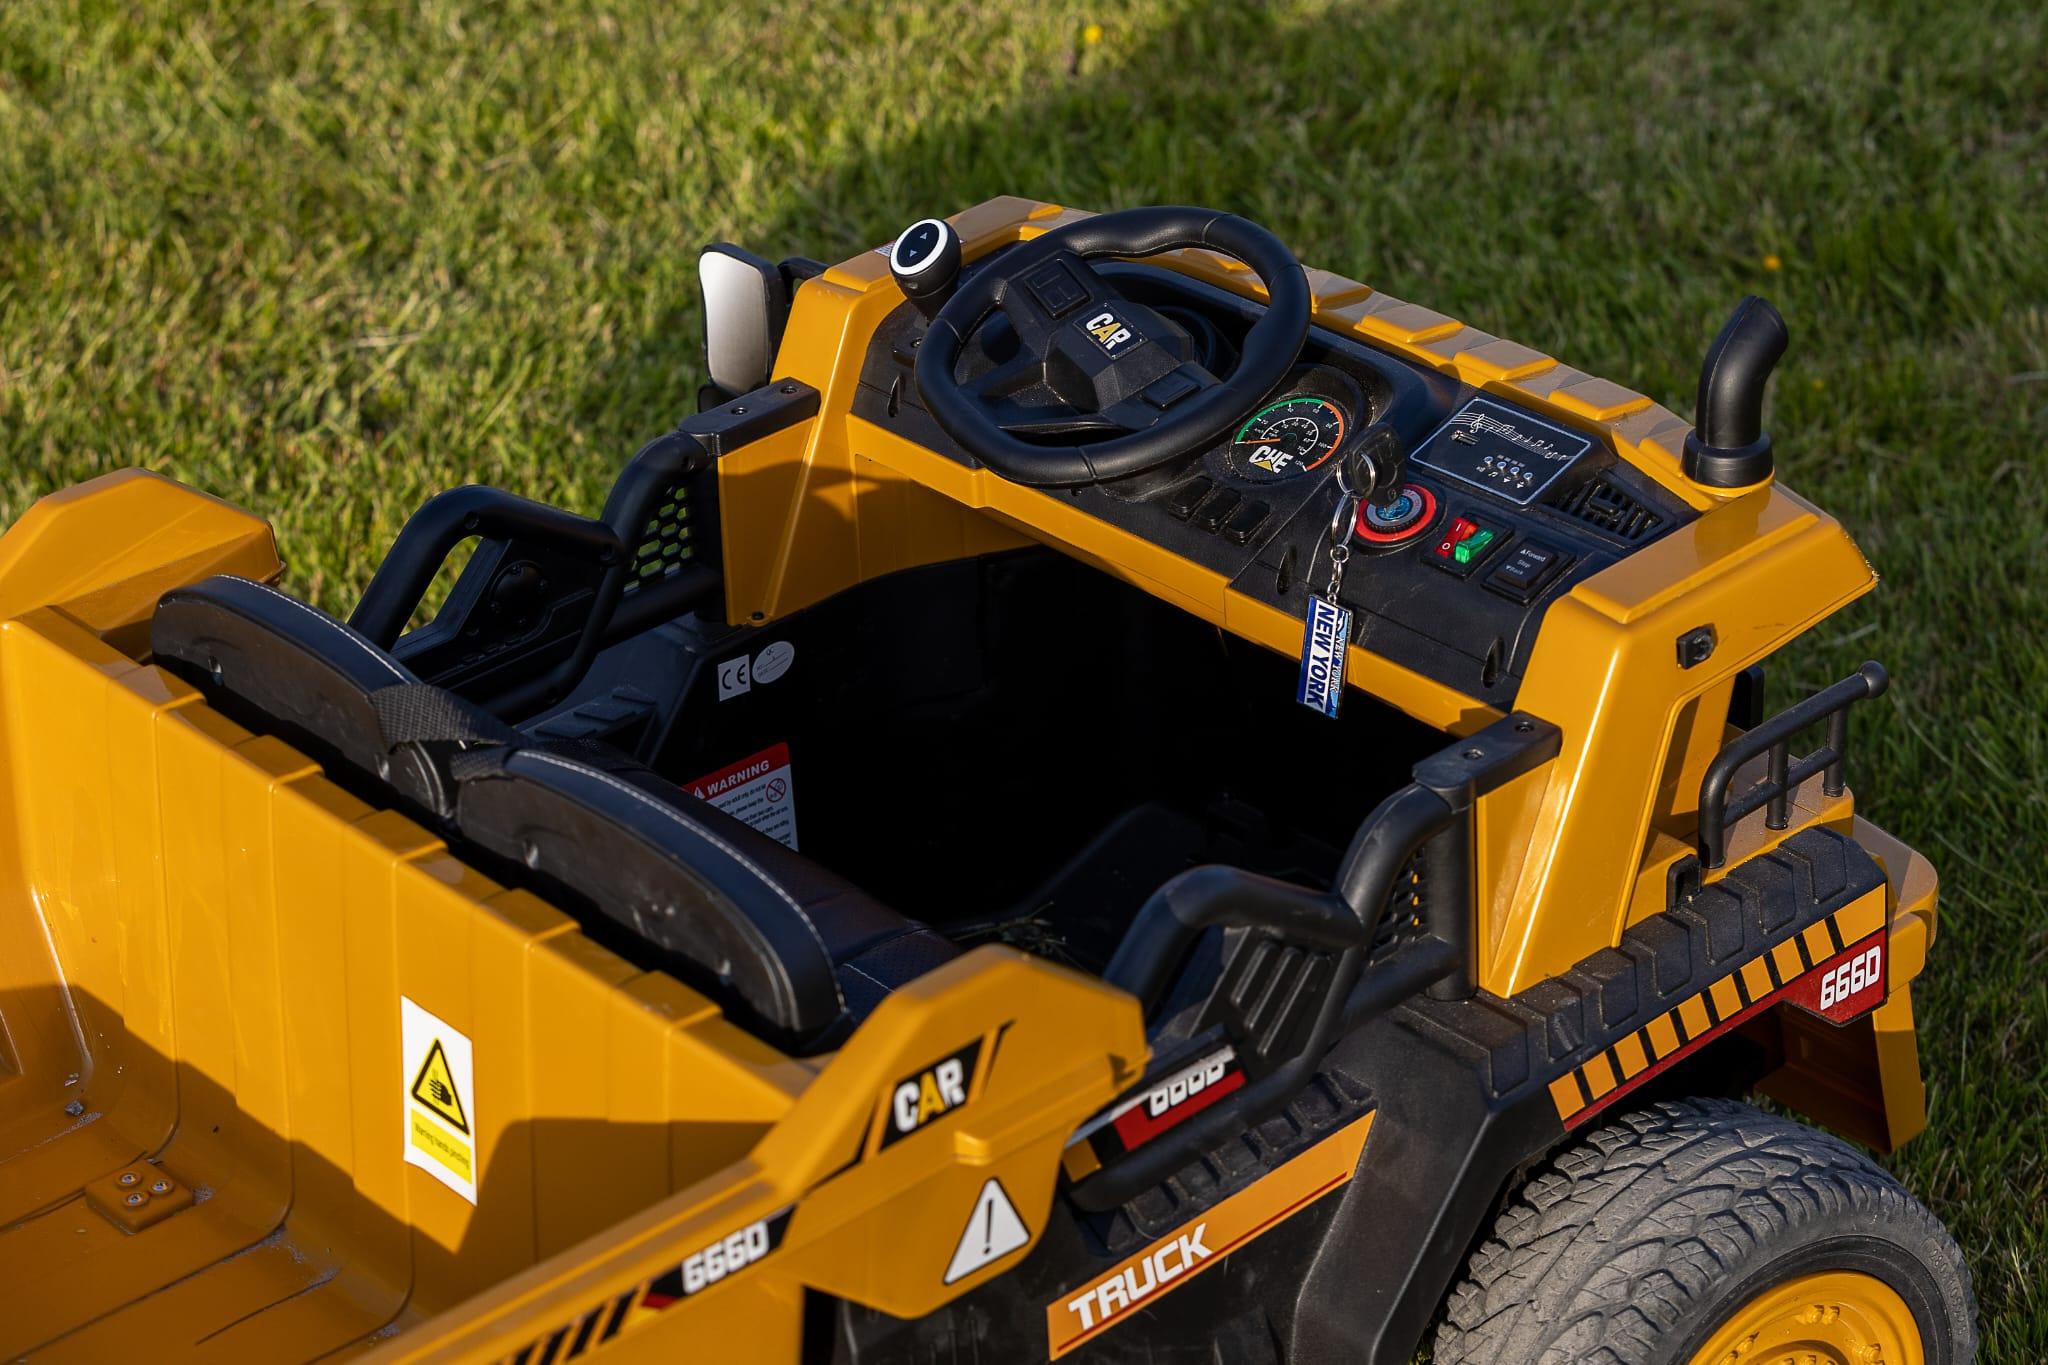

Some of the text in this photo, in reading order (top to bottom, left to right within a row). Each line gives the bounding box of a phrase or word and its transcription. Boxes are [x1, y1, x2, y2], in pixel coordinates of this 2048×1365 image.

[1086, 313, 1132, 350] CAR
[1306, 604, 1335, 709] NEW YORK
[707, 760, 770, 796] WARNING
[893, 1058, 965, 1132] CAR
[1068, 1222, 1213, 1332] TRUCK
